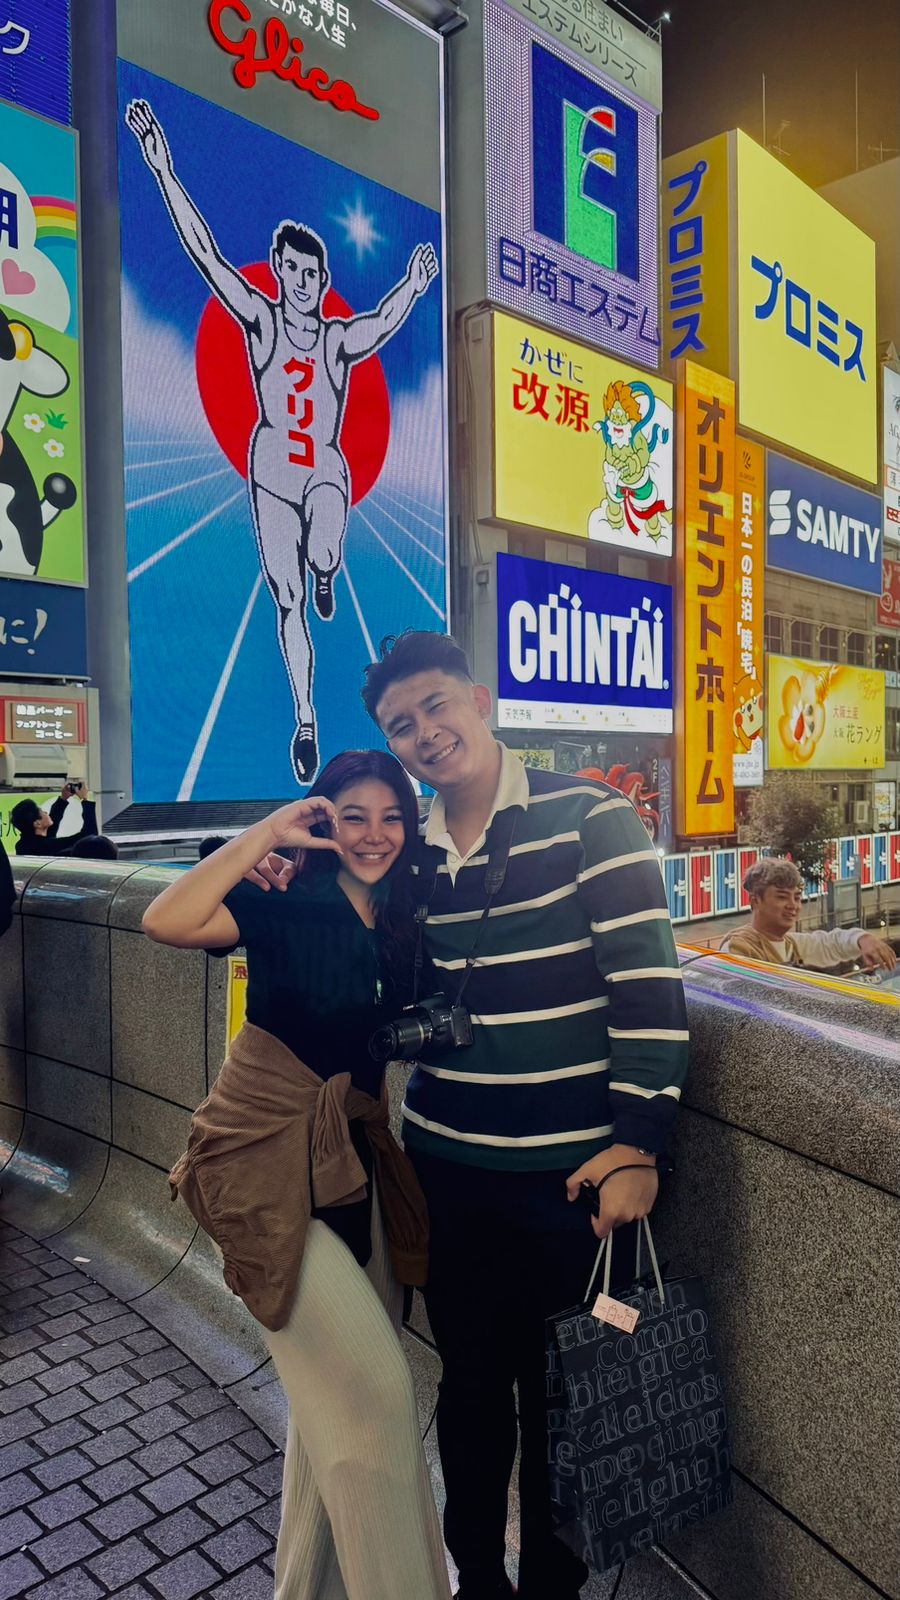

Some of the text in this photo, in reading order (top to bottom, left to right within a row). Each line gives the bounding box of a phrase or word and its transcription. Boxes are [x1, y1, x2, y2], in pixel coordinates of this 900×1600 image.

[207, 0, 380, 121] Glico
[499, 236, 661, 345] 日商エステム
[668, 160, 706, 359] プロミス
[519, 337, 584, 383] かぜに
[750, 255, 867, 382] プロミス
[283, 355, 316, 467] グリコ
[512, 367, 590, 433] 改源
[797, 498, 880, 564] SAMTY
[508, 584, 665, 690] CHINTAI
[696, 397, 724, 804] オリエントホーム
